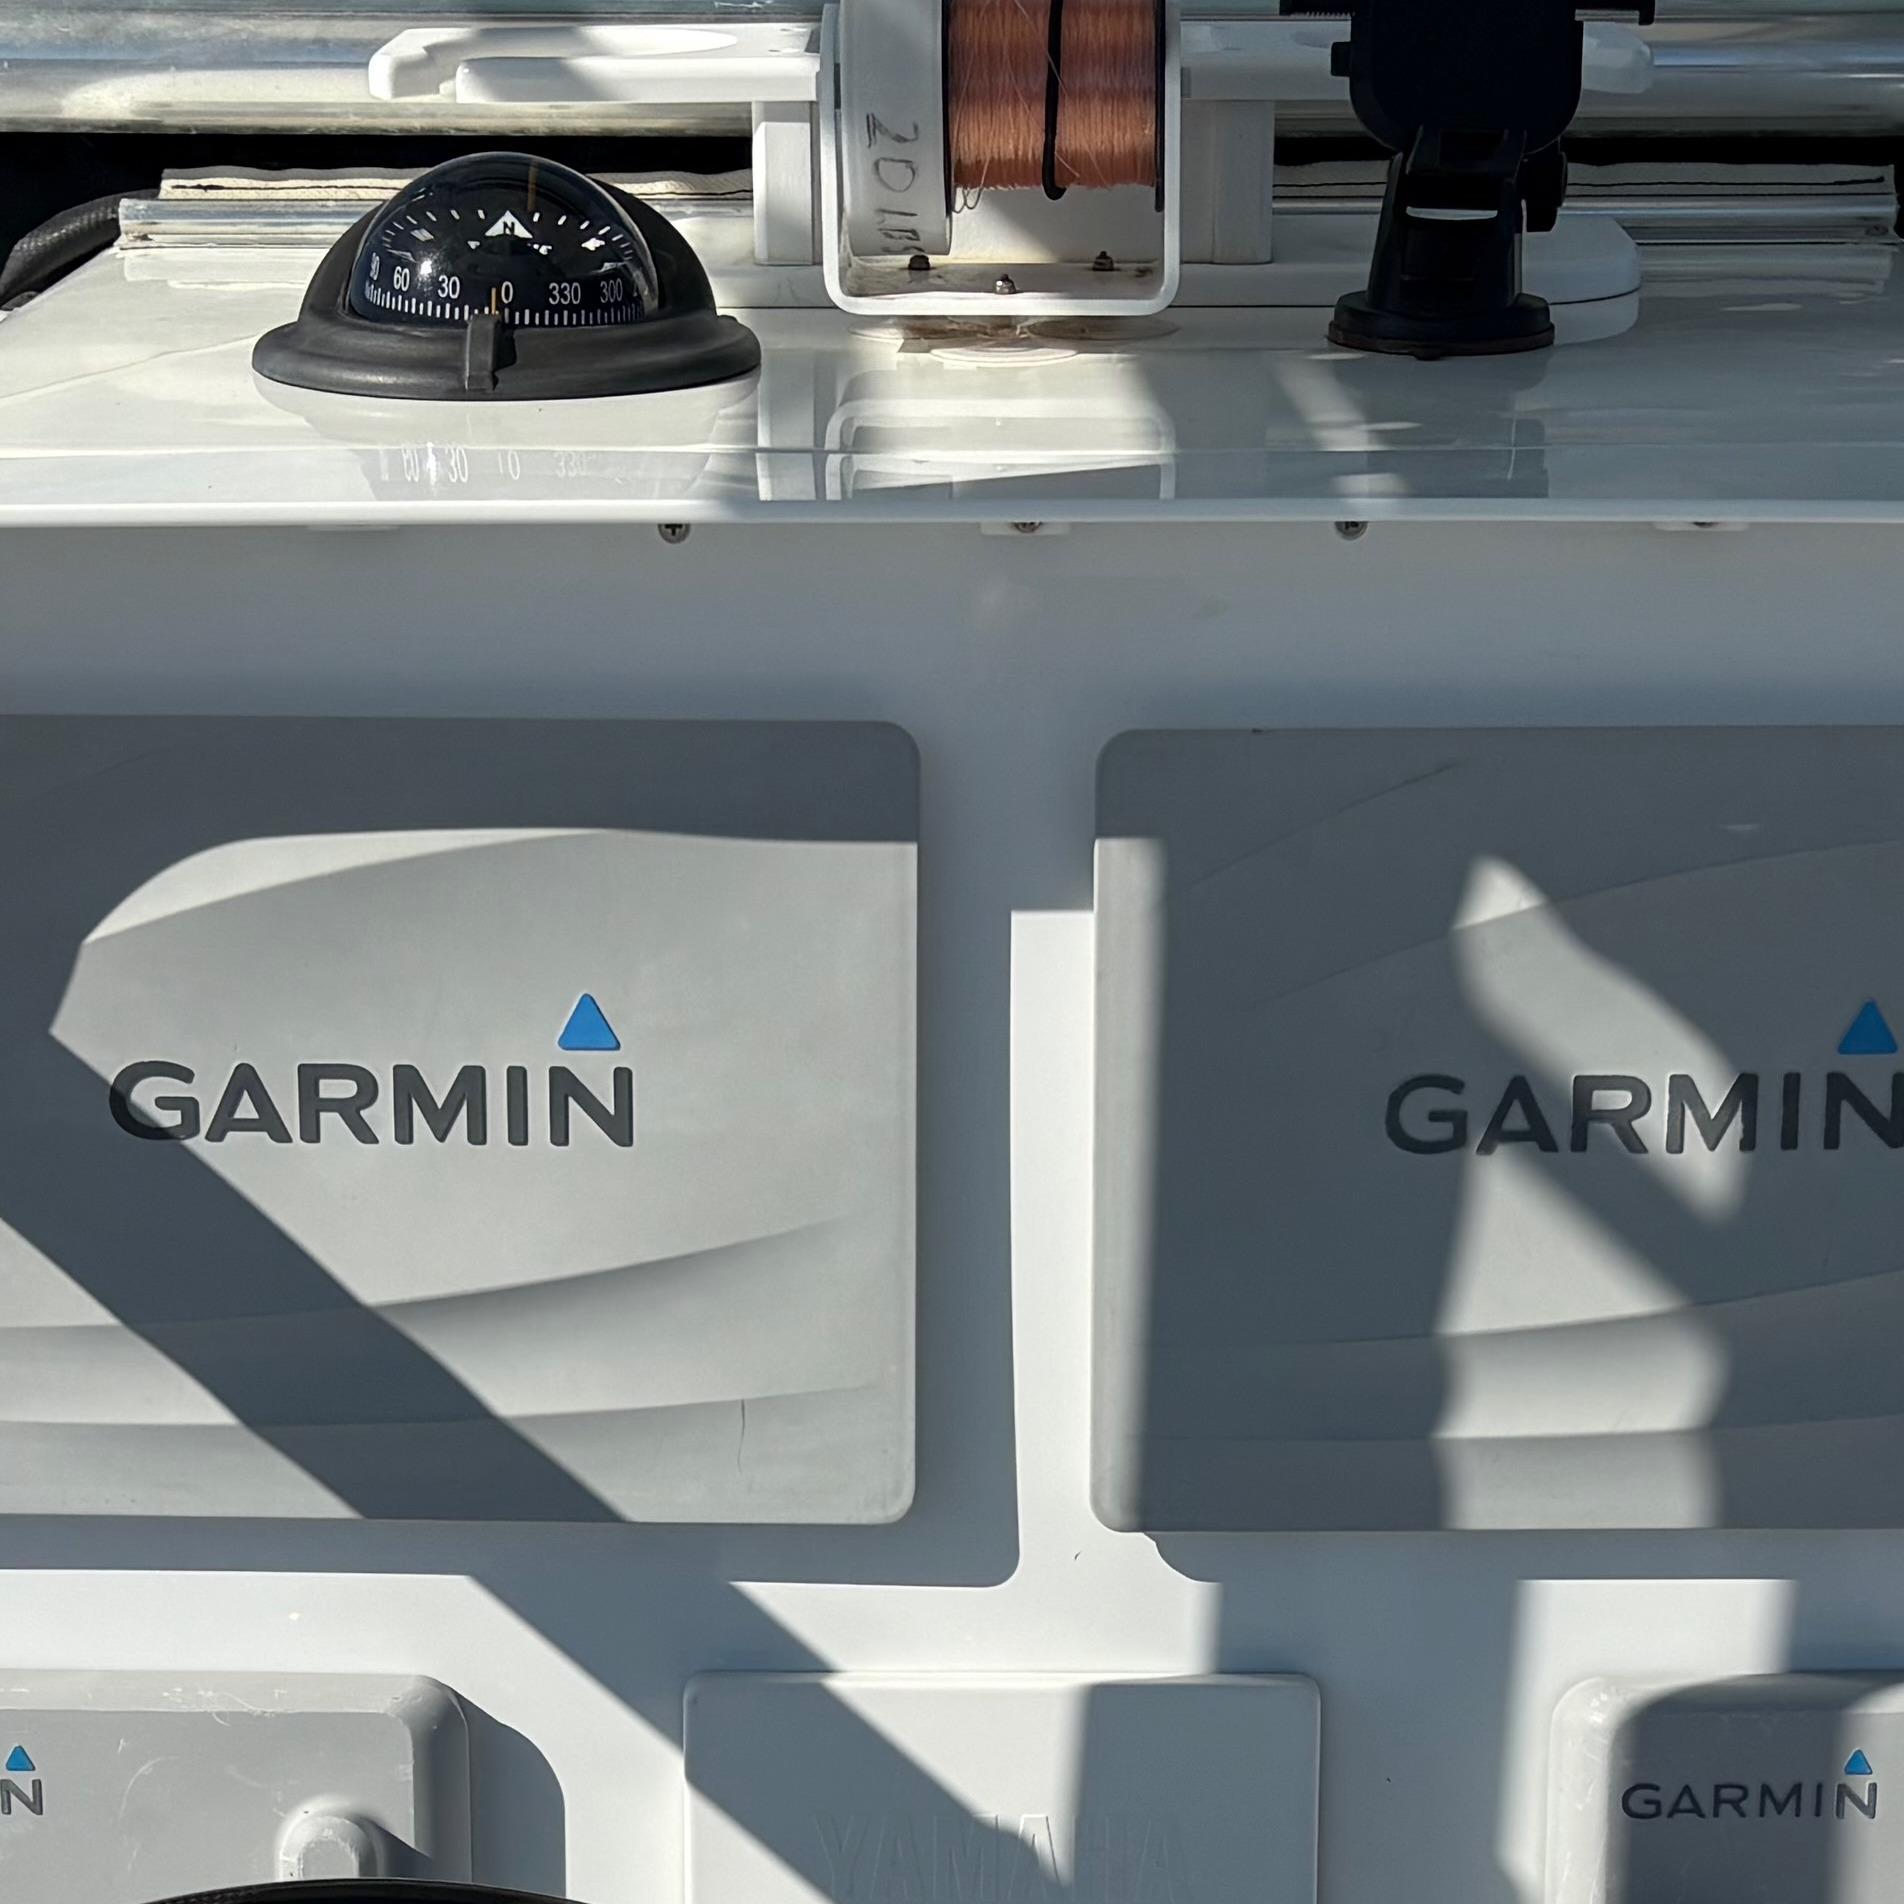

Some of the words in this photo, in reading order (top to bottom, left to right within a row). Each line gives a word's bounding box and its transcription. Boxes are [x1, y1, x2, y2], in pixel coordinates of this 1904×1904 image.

[503, 222, 515, 235] N
[393, 266, 410, 292] 60
[438, 275, 461, 299] 30
[501, 281, 514, 304] 0
[548, 282, 581, 305] 330
[599, 278, 623, 304] 300
[108, 1060, 634, 1148] GARMIN
[1620, 1781, 1878, 1820] GARMIN
[812, 1813, 1192, 1904] YAMAHA
